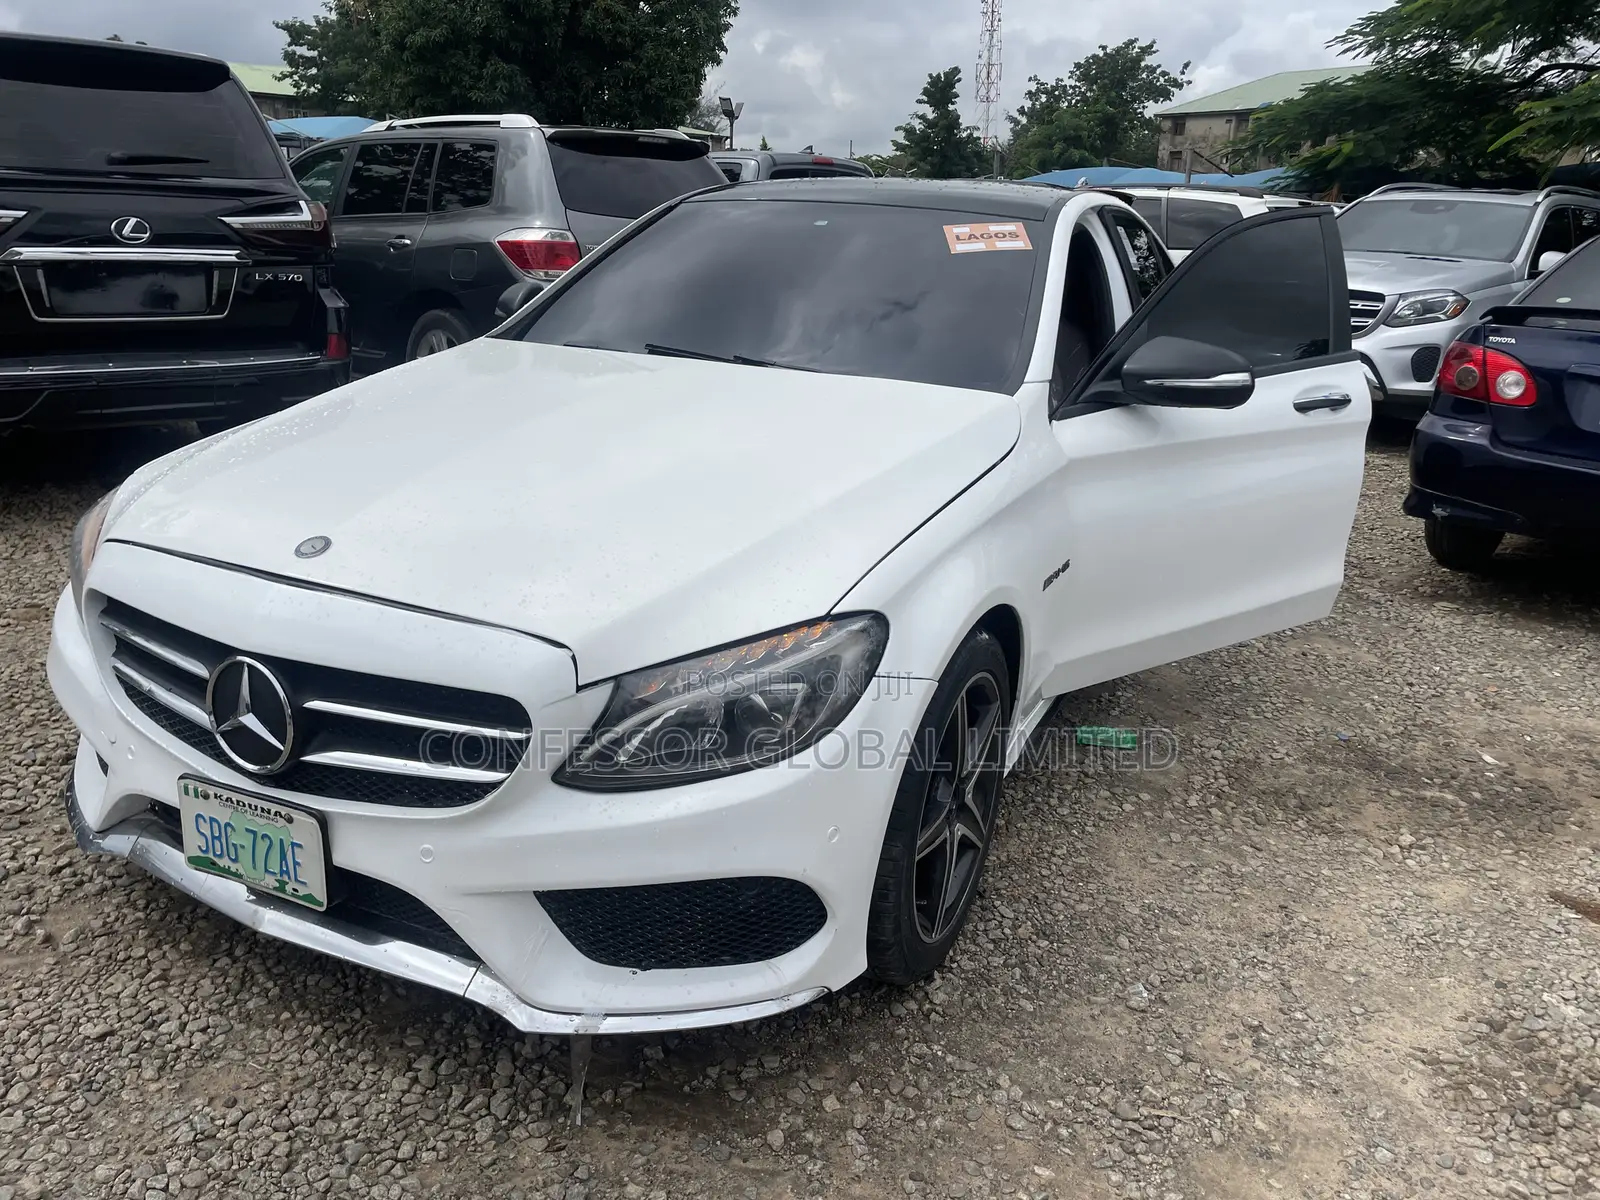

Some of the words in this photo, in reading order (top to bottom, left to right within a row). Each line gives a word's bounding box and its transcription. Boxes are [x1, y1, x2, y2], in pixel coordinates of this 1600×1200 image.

[954, 231, 1020, 241] LAGOS
[255, 272, 273, 281] LX
[278, 273, 303, 282] 570
[1488, 336, 1516, 344] TOYOTA
[213, 791, 285, 819] KADUNA
[218, 801, 240, 813] CENTRE
[240, 807, 248, 815] OF
[249, 810, 279, 823] LEARNING
[194, 812, 307, 885] SBG-72AE
